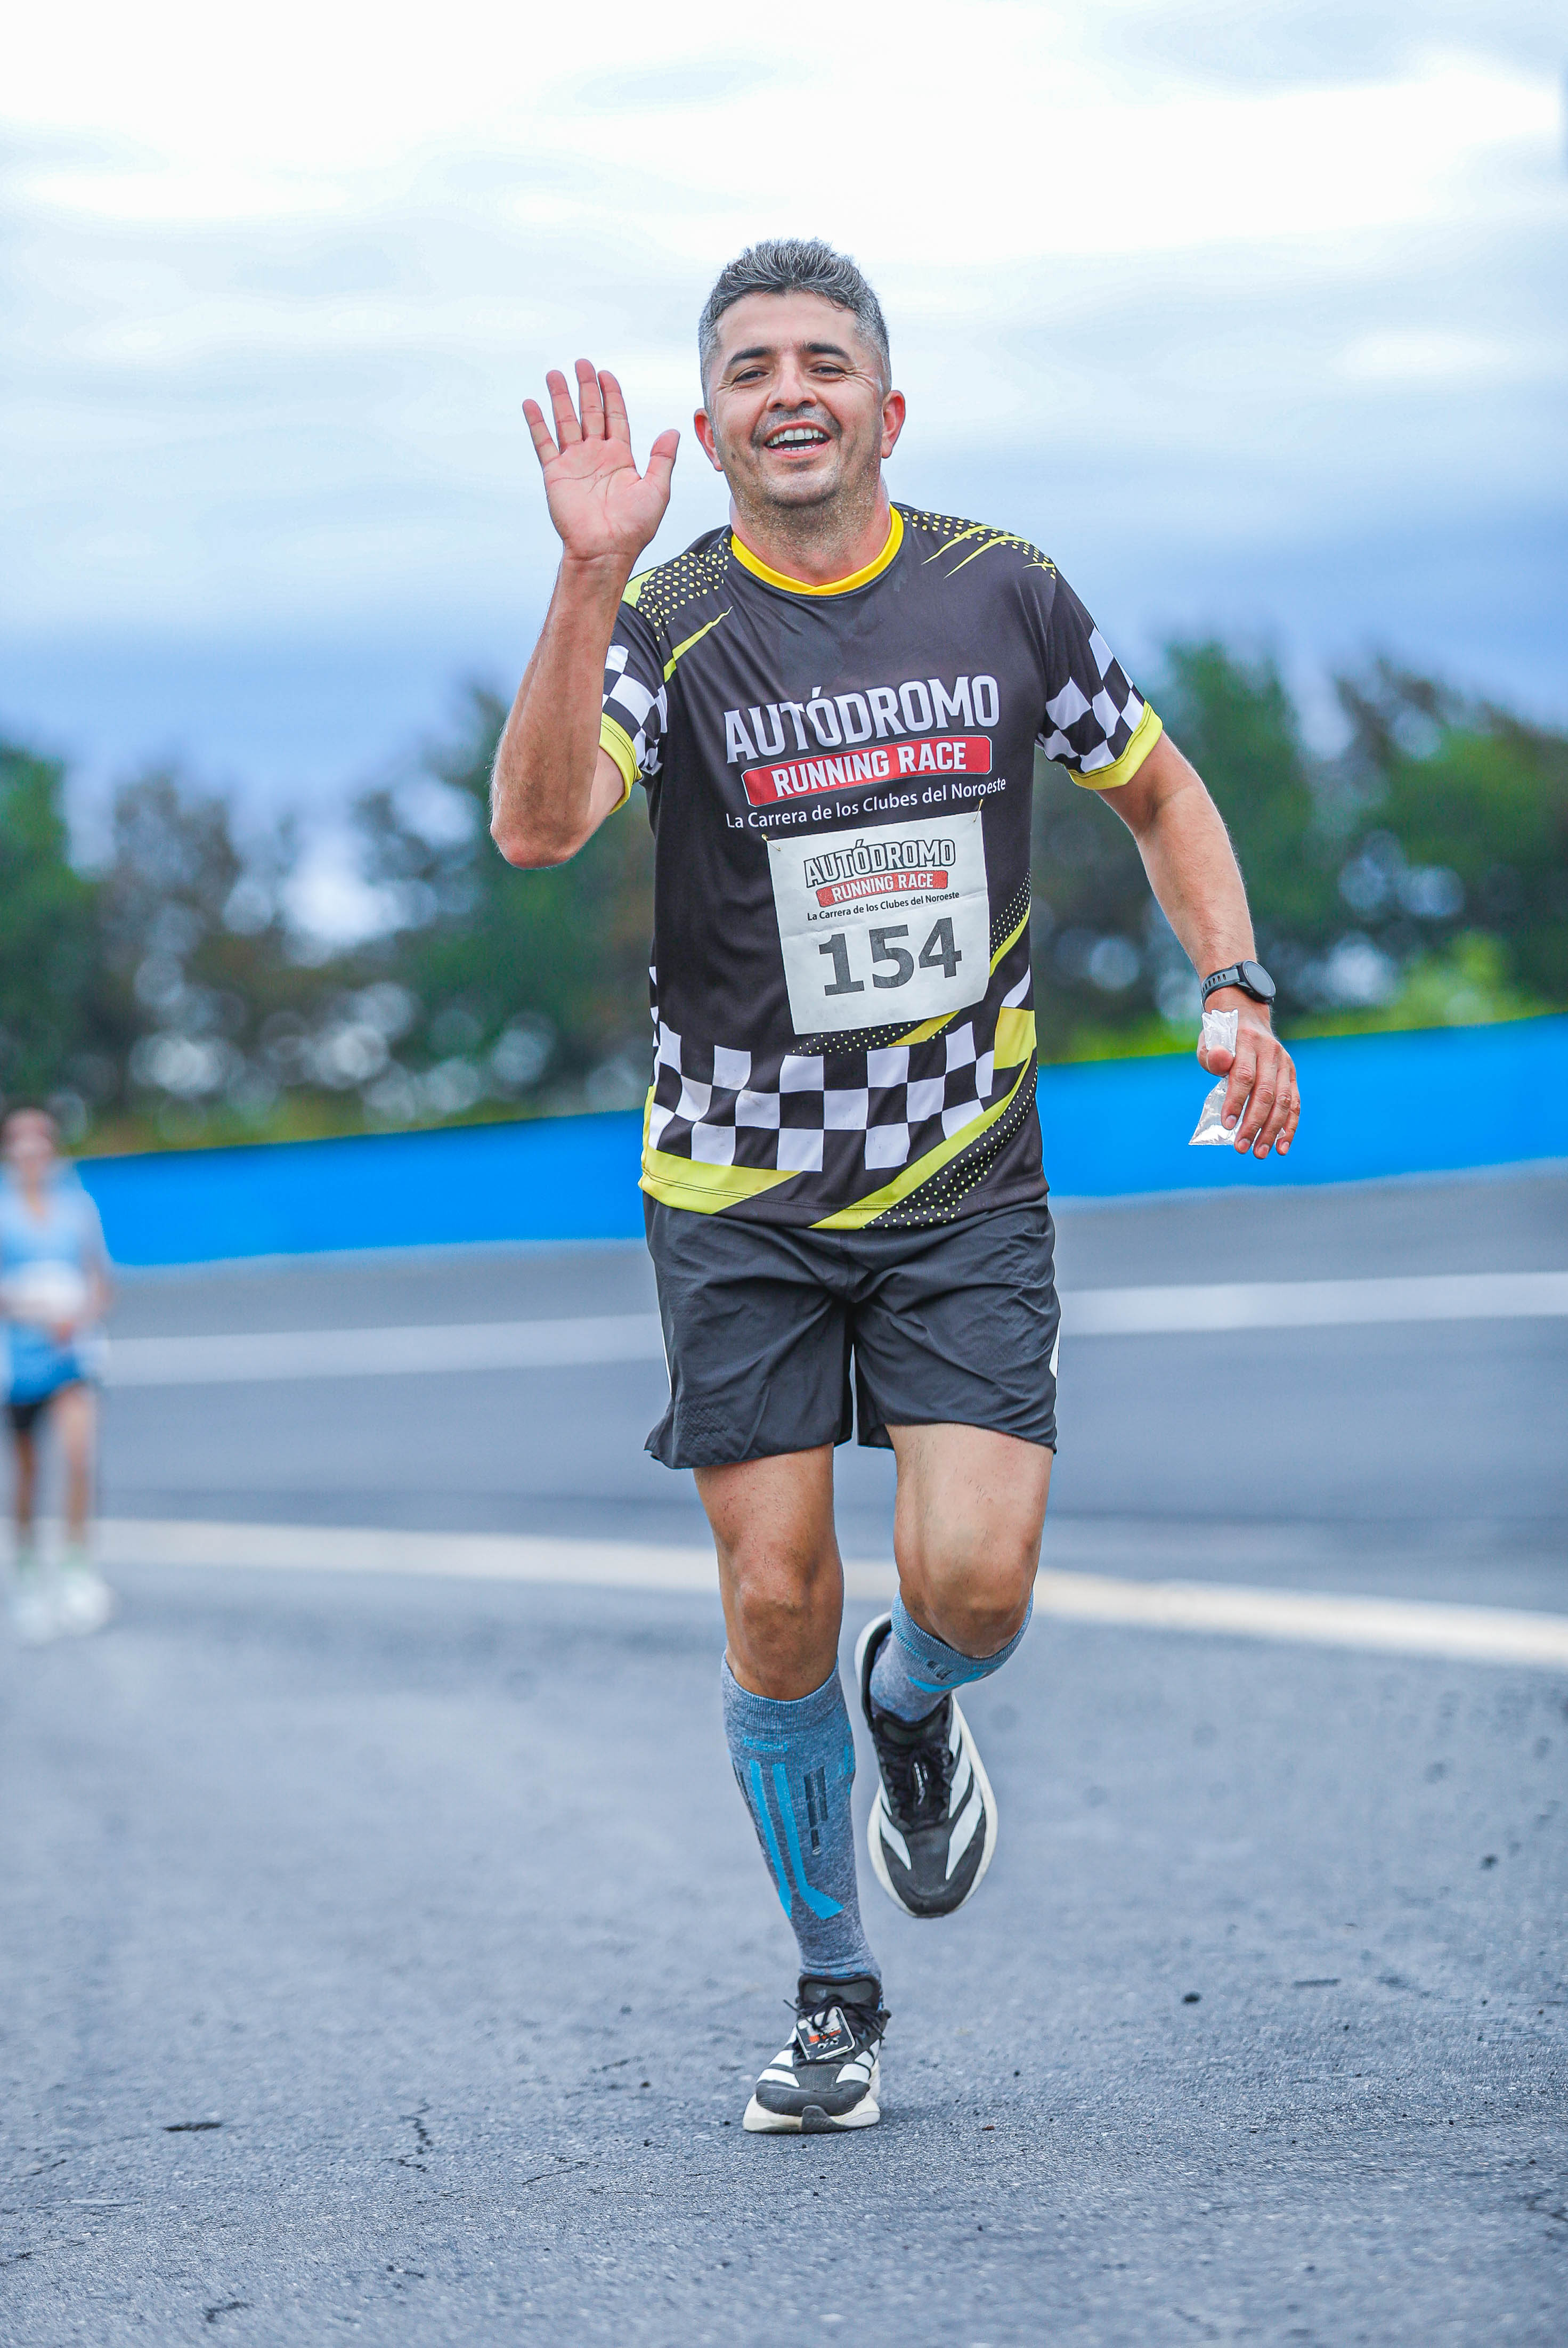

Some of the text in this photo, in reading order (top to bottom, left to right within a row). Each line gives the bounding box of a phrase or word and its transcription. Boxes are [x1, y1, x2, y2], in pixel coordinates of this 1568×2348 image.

[723, 674, 1001, 764] AUTÓDROMO
[770, 742, 966, 798] RUNNING RACE
[726, 777, 1006, 828] La Carrera de los Clubes del Noroeste
[803, 839, 956, 888] AUTÓDROMO
[831, 873, 934, 904] RUNNING RACE
[807, 891, 960, 921] La Carrera de los Clubes del Noroeste
[818, 916, 963, 996] 154
